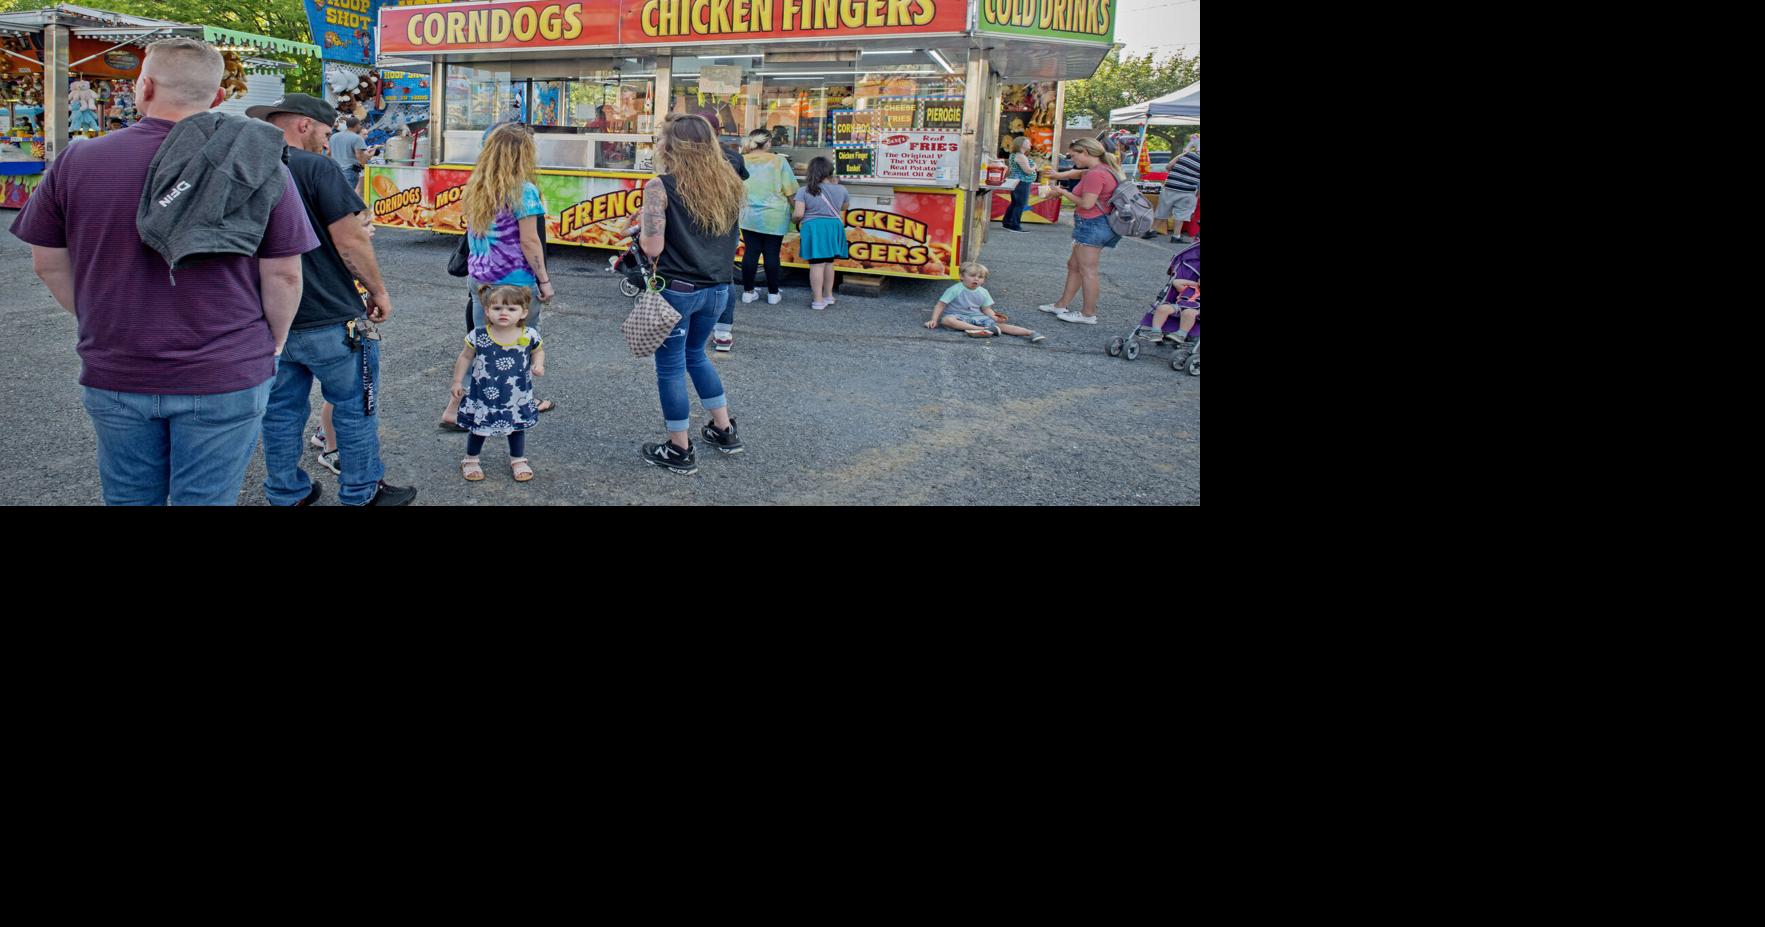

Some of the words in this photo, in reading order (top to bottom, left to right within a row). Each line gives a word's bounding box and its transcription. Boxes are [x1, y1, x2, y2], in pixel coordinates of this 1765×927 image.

[326, 8, 371, 30] SHOT
[407, 3, 583, 46] CORNDOGS
[640, 0, 773, 37] CHICKEN
[781, 0, 936, 32] FINGERS
[983, 0, 1037, 27] COLD
[1038, 0, 1110, 36] DRINKS
[901, 152, 935, 160] Original
[909, 142, 958, 152] FRIES
[374, 187, 421, 215] CORNDOGS
